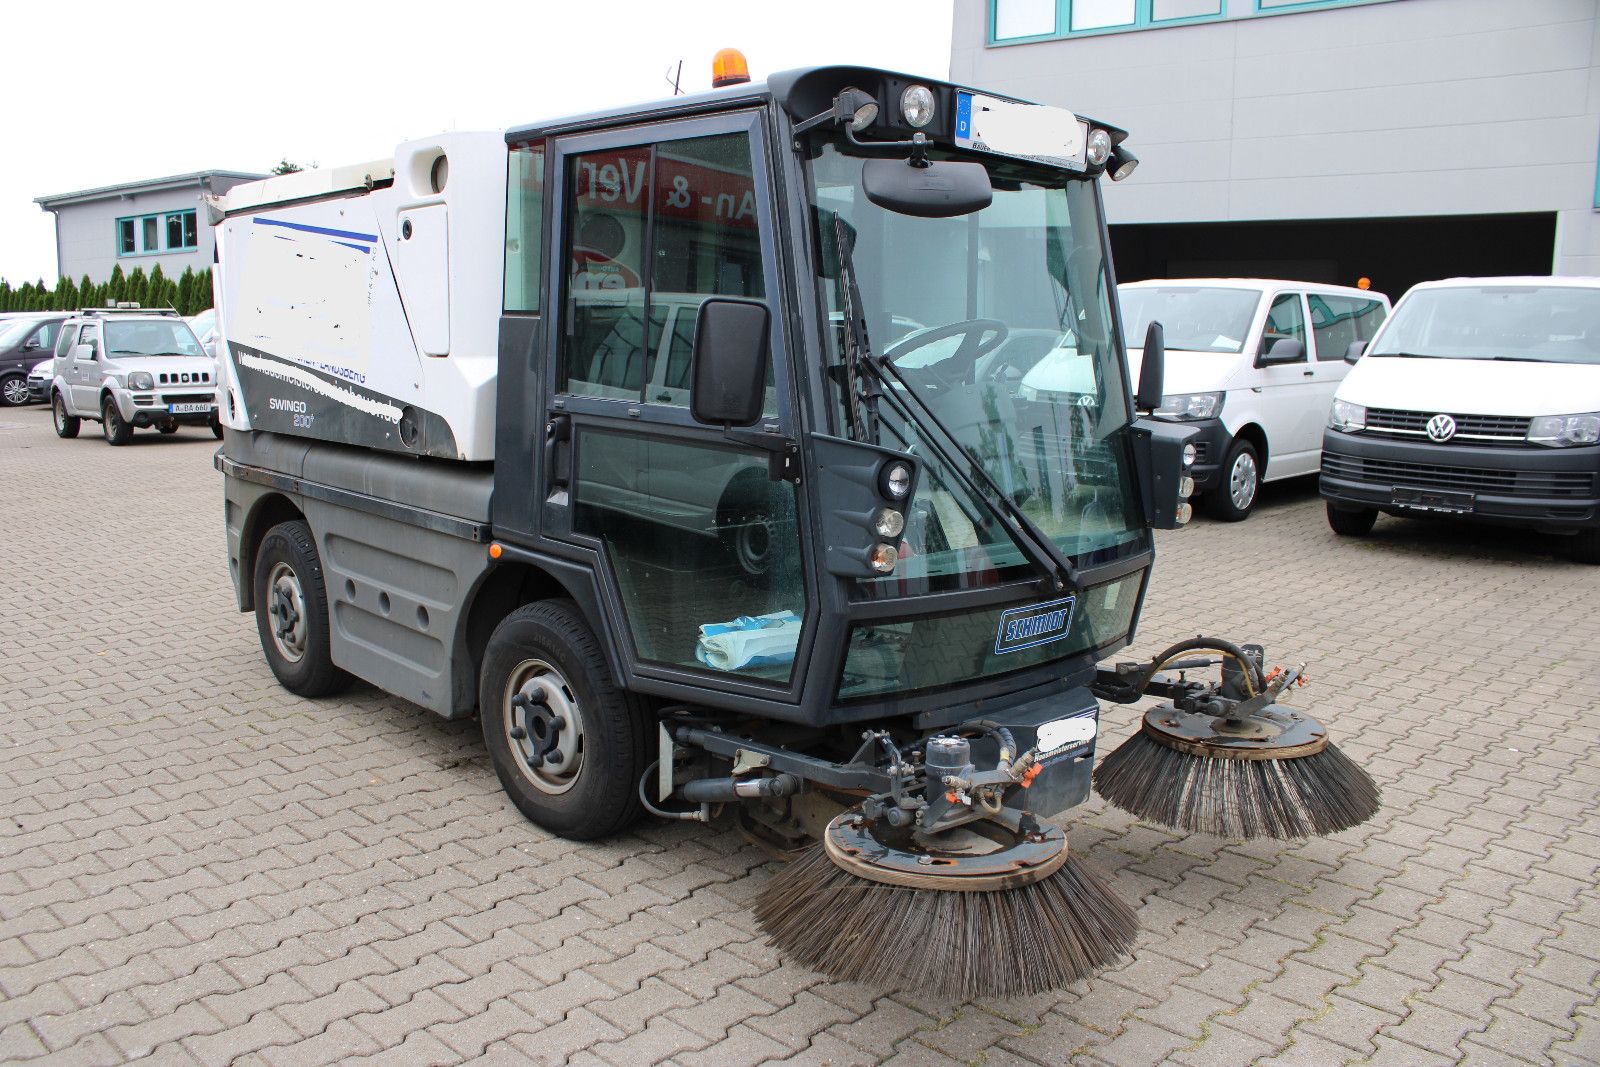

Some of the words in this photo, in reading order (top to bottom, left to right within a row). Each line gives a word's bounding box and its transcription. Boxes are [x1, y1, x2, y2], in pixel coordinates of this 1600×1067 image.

[960, 120, 967, 132] D
[269, 397, 307, 414] SWINGO
[1005, 608, 1068, 642] SCHMIDT
